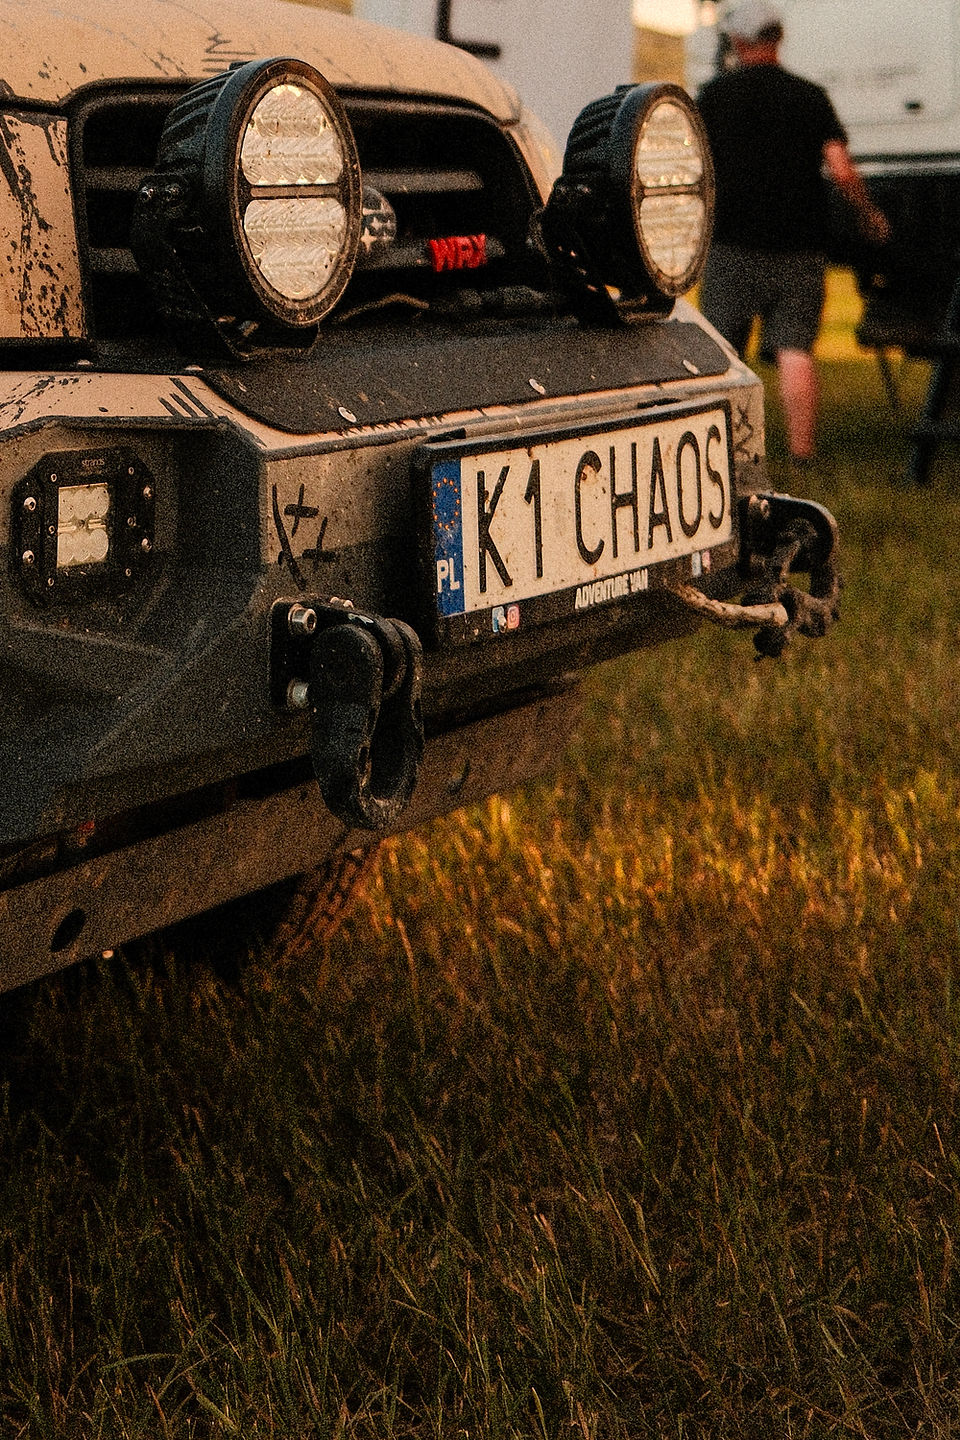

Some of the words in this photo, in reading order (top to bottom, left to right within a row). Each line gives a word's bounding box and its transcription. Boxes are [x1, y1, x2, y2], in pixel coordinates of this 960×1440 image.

[429, 233, 487, 272] WRX
[476, 458, 543, 594] K1
[574, 425, 726, 566] CHAOS
[436, 558, 460, 593] PL
[574, 573, 629, 610] ADVENTURE
